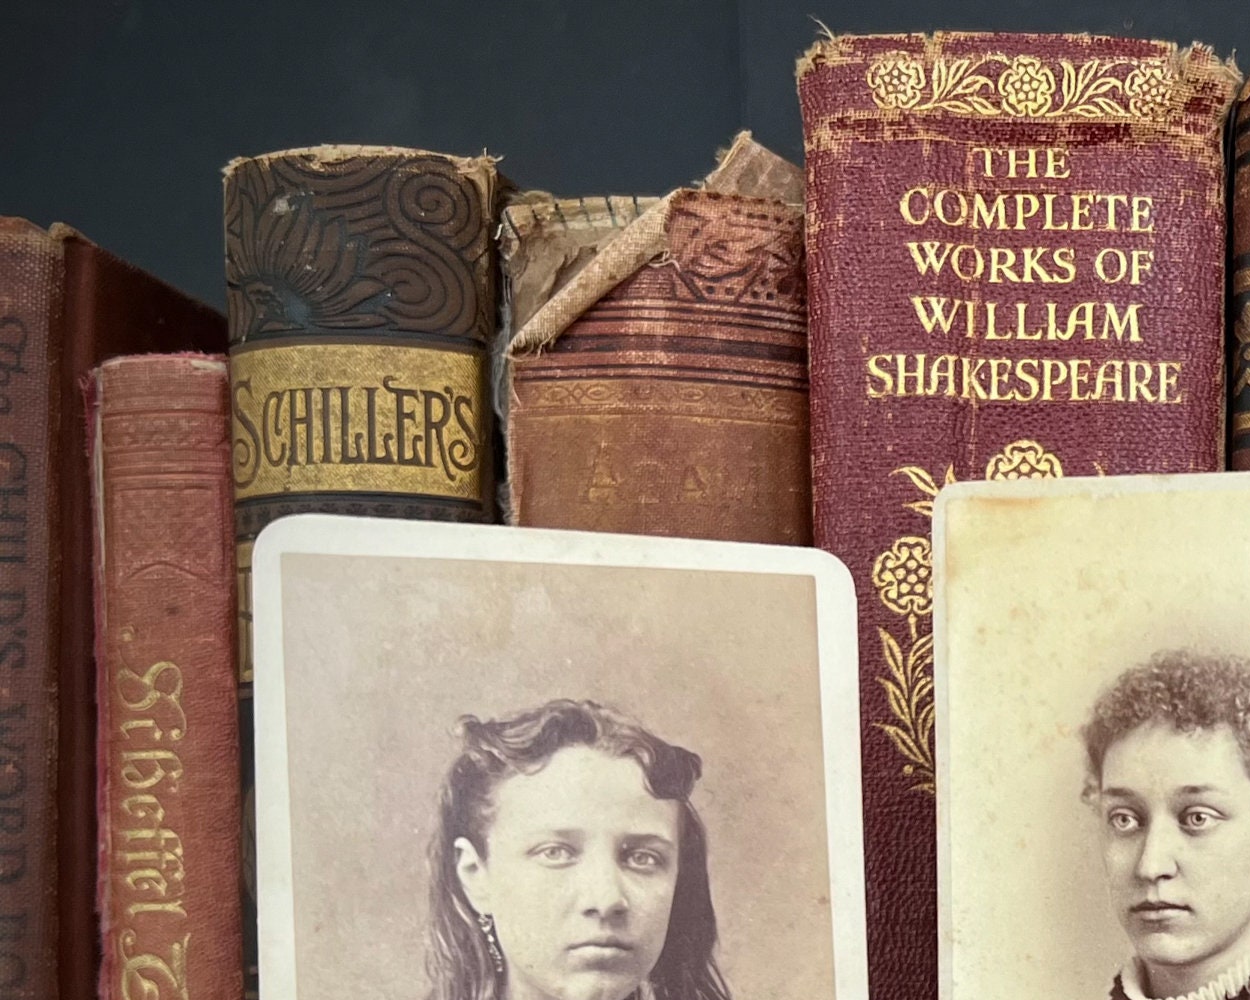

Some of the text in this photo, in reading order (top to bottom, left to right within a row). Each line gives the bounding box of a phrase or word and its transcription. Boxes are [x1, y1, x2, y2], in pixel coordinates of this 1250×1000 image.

[972, 146, 1073, 179] THE
[898, 186, 1155, 234] COMPLETE
[906, 240, 1155, 286] WORKS OF
[910, 295, 1145, 343] WILLIAM
[866, 352, 1183, 405] SHAKESPEARE
[232, 375, 479, 490] SCHILLER'S
[0, 702, 28, 886] WORD
[117, 656, 187, 918] Scheffel
